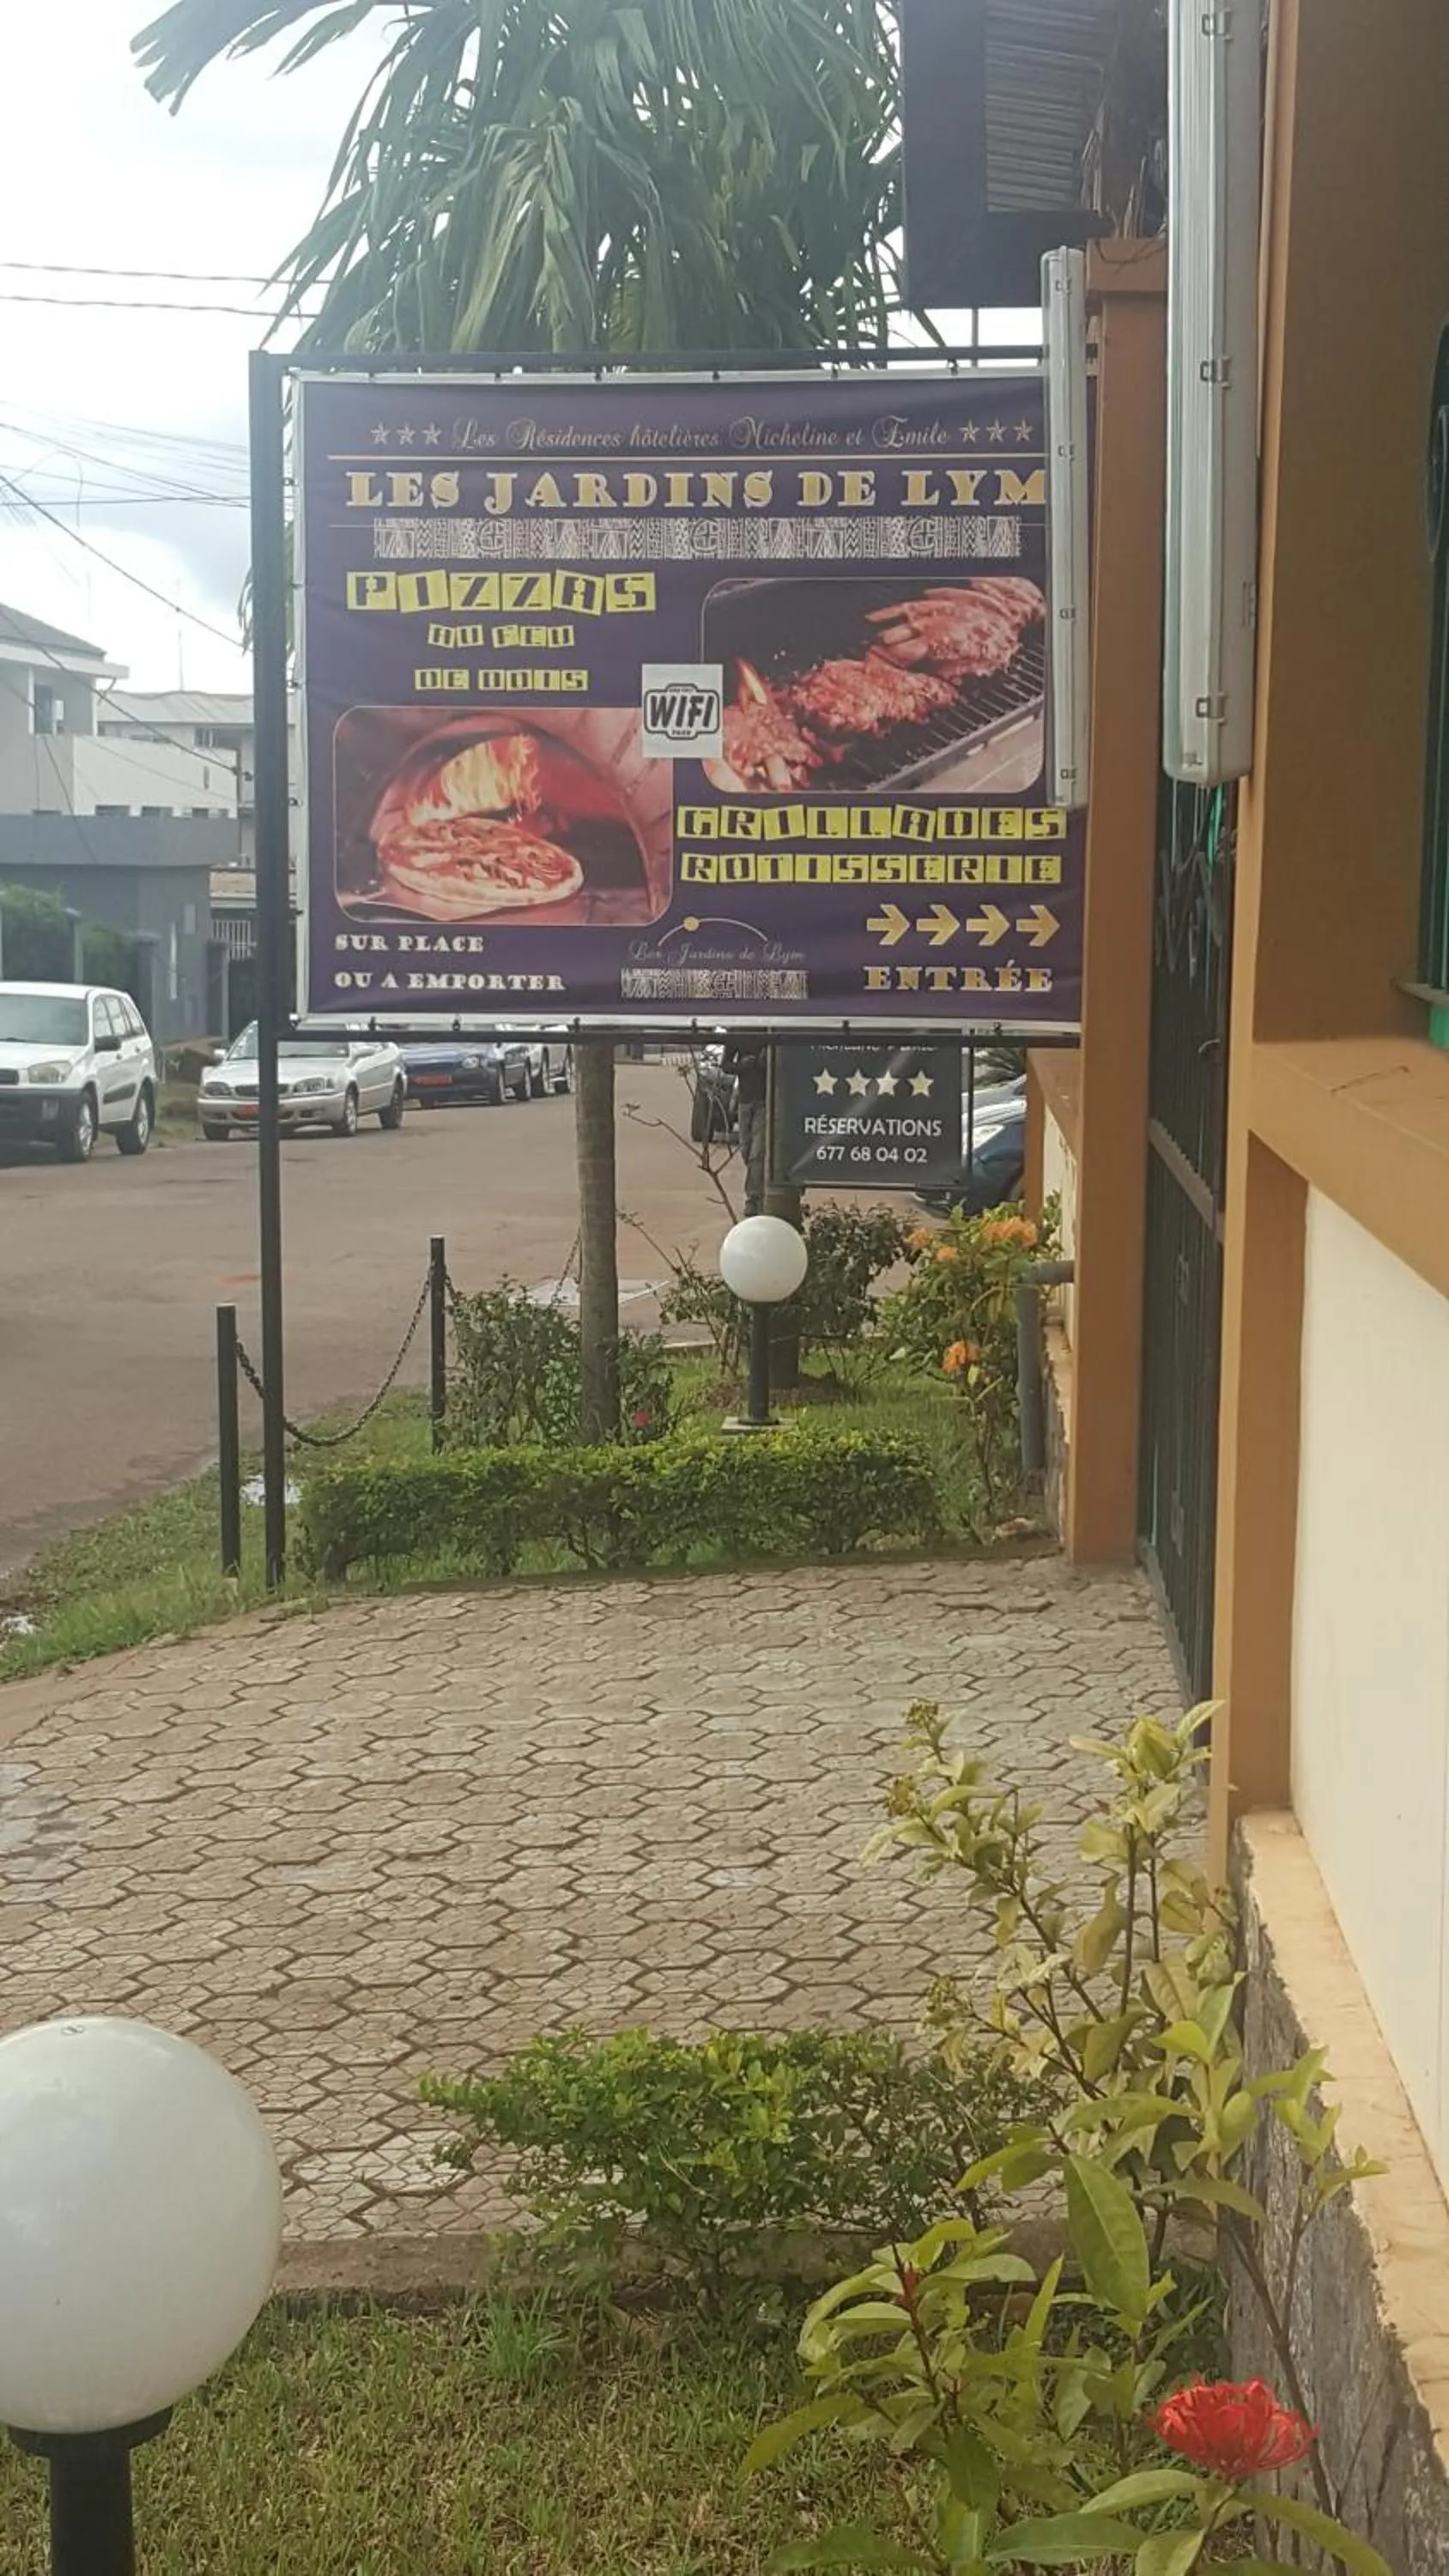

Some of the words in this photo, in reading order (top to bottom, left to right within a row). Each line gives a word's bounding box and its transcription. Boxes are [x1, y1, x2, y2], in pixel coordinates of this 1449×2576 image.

[452, 416, 496, 450] Les
[506, 416, 622, 450] Résidences
[846, 428, 864, 447] et
[872, 414, 950, 448] Emile
[345, 471, 461, 508] LES
[483, 469, 773, 515] JARDINS
[797, 470, 876, 507] DE
[900, 469, 1047, 506] LYM
[351, 573, 652, 613] PIZZAS
[431, 625, 482, 646] AU
[494, 625, 573, 646] FEU
[417, 670, 466, 689] DE
[650, 695, 715, 728] WIFI
[683, 808, 1062, 839] GRILLADES
[684, 855, 1057, 882] ROTISSERIE
[334, 933, 390, 951] SUR
[397, 934, 484, 953] PLACE
[334, 971, 373, 988] OU
[381, 974, 399, 989] A
[406, 973, 566, 991] EMPORTER
[863, 957, 1054, 993] ENTRÉE
[803, 1114, 943, 1138] RÉSERVATIONS
[816, 1145, 846, 1161] 677
[851, 1146, 871, 1162] 68
[876, 1147, 899, 1163] 04
[904, 1148, 928, 1163] 02
